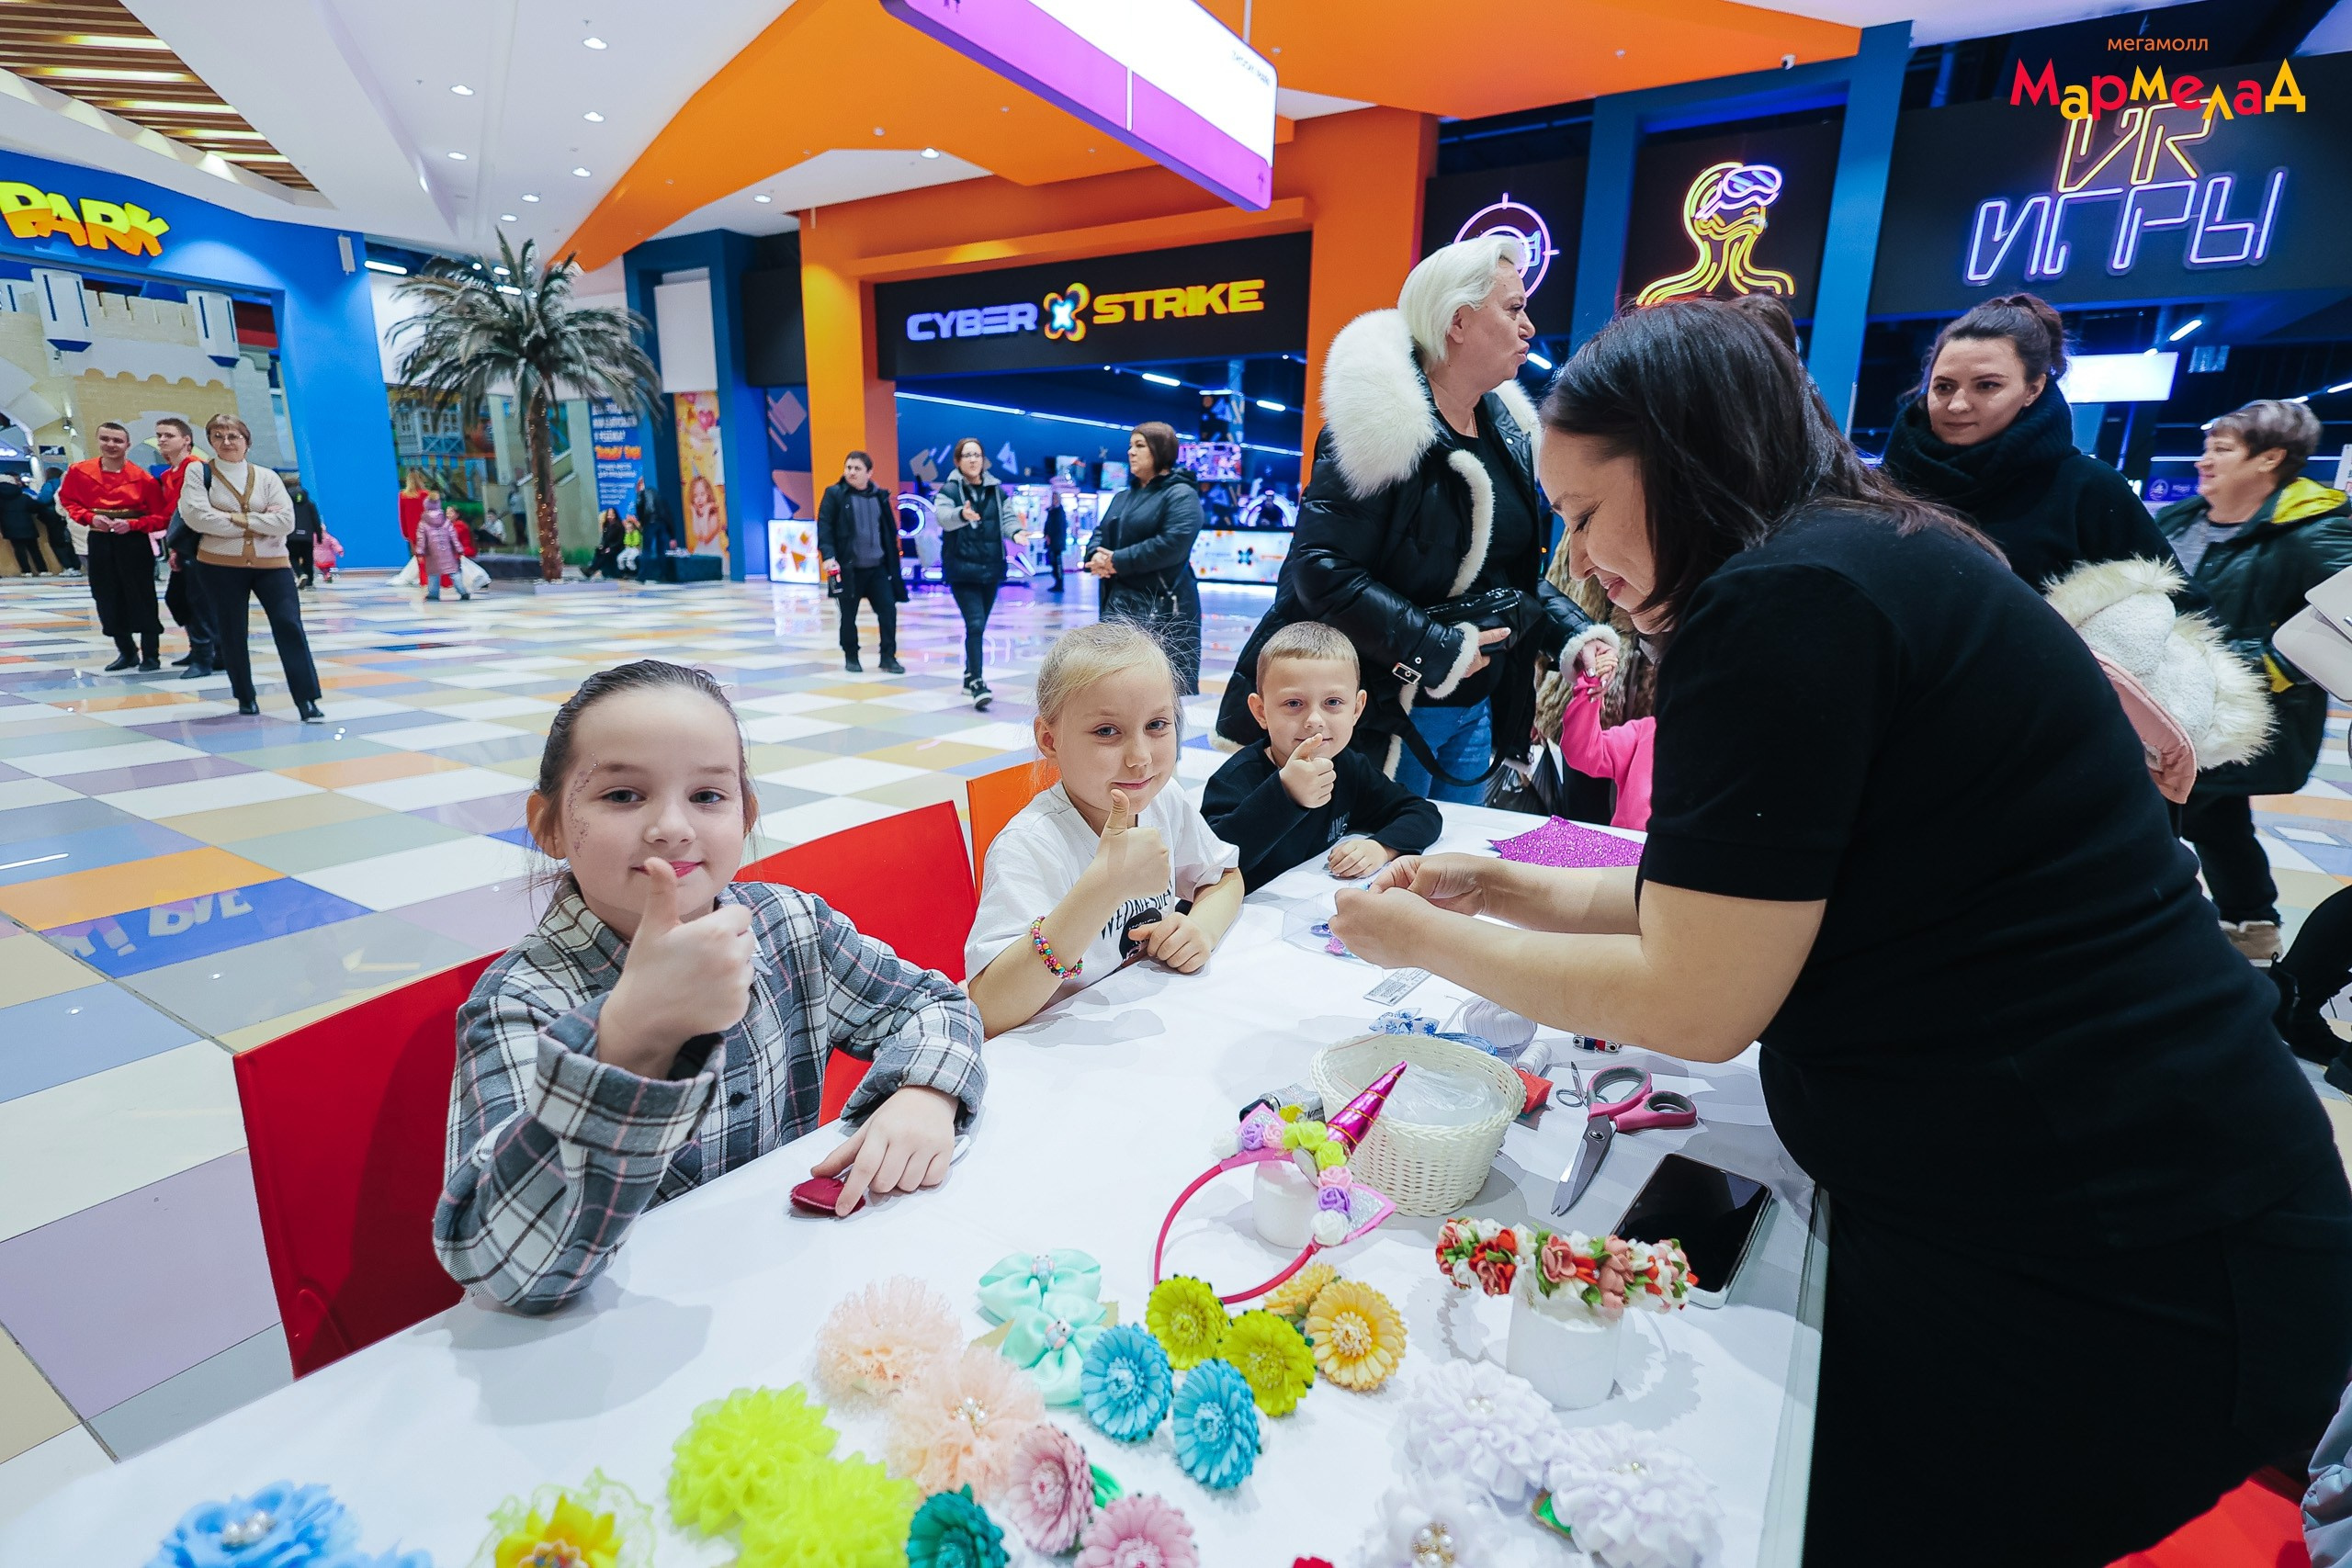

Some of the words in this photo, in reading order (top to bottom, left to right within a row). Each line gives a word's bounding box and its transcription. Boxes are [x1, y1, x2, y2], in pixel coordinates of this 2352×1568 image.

[2056, 96, 2213, 194] VR
[0, 180, 171, 257] PARK
[1966, 170, 2286, 281] ИГРЫ
[906, 301, 1039, 342] CYBER
[1092, 278, 1266, 324] STRIKE
